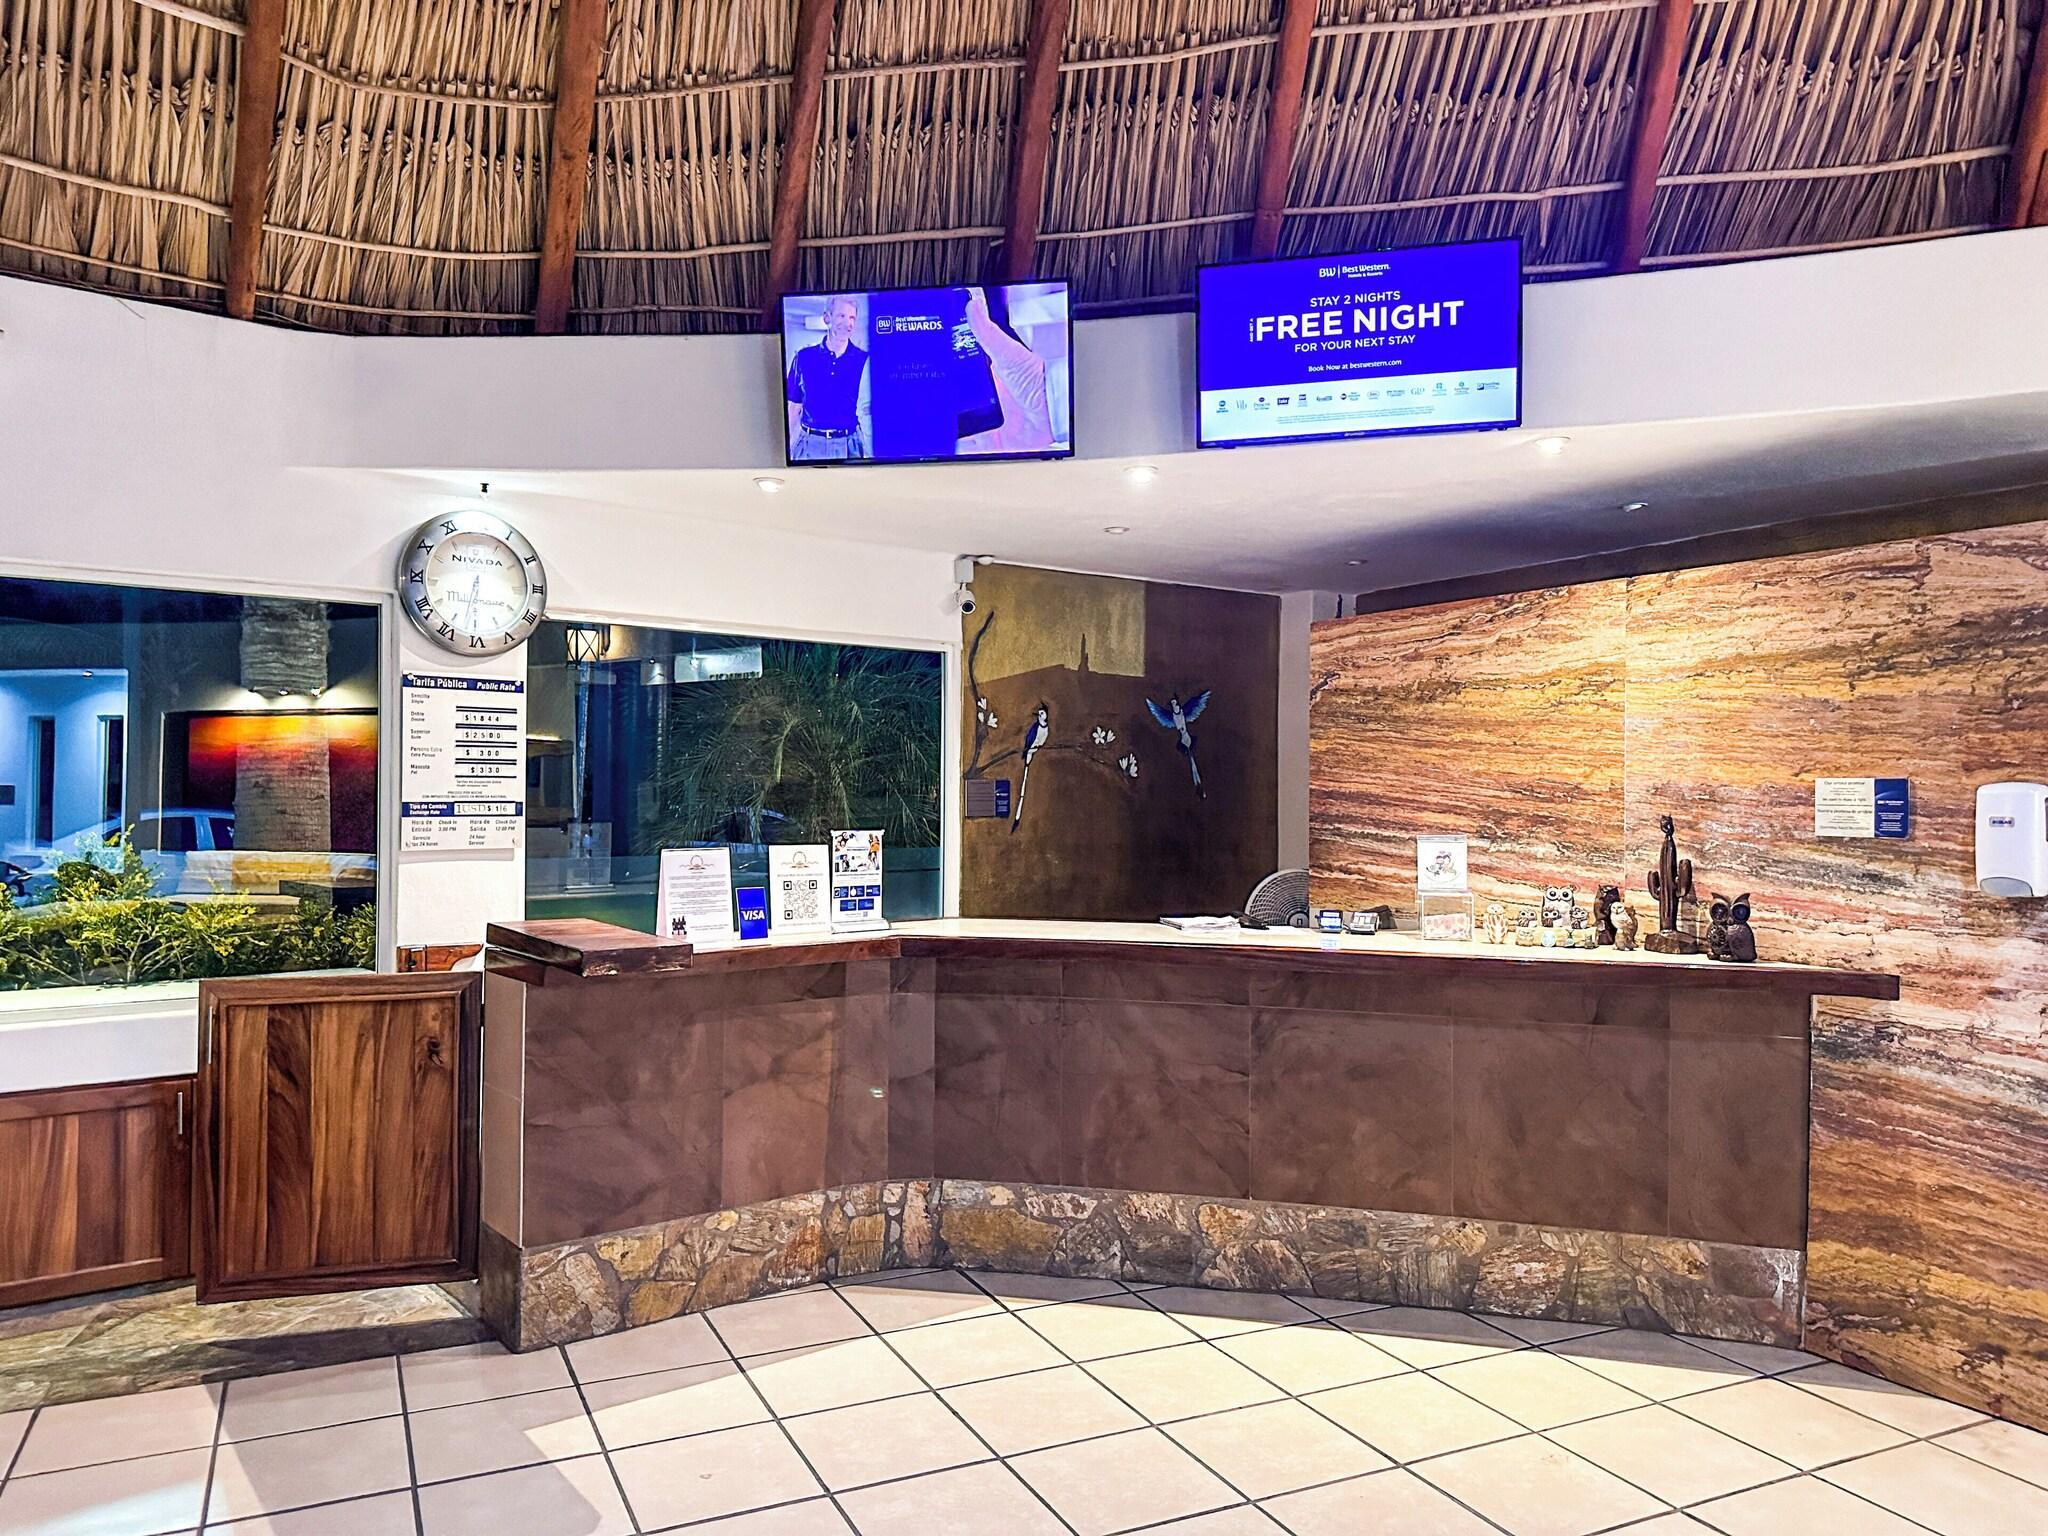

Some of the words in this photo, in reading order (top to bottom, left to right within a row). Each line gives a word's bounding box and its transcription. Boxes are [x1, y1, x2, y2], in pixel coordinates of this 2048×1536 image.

[1319, 267, 1336, 278] BW
[1310, 296, 1340, 307] STAY
[1344, 295, 1351, 304] 2
[1355, 290, 1400, 303] NIGHTS
[878, 320, 891, 328] BW
[896, 321, 943, 332] REWARDS
[1256, 310, 1343, 342] FREE
[1353, 300, 1464, 334] NIGHT
[1294, 342, 1318, 352] FOR
[1320, 340, 1352, 350] YOUR
[1355, 337, 1385, 348] NEXT
[1388, 334, 1416, 346] STAY
[1350, 360, 1402, 369] bestwestern.com
[440, 520, 458, 536] XI
[504, 531, 514, 541] I
[417, 539, 435, 556] X
[452, 554, 502, 567] NIVADA
[524, 554, 538, 565] II
[410, 568, 424, 584] IX
[532, 584, 544, 596] III
[414, 596, 434, 622] VIII
[436, 622, 456, 642] VII
[504, 631, 516, 645] V
[468, 635, 486, 648] VI
[412, 678, 435, 687] Tarifa
[438, 678, 468, 689] Pública
[476, 682, 498, 690] Public
[740, 910, 765, 920] VISA
